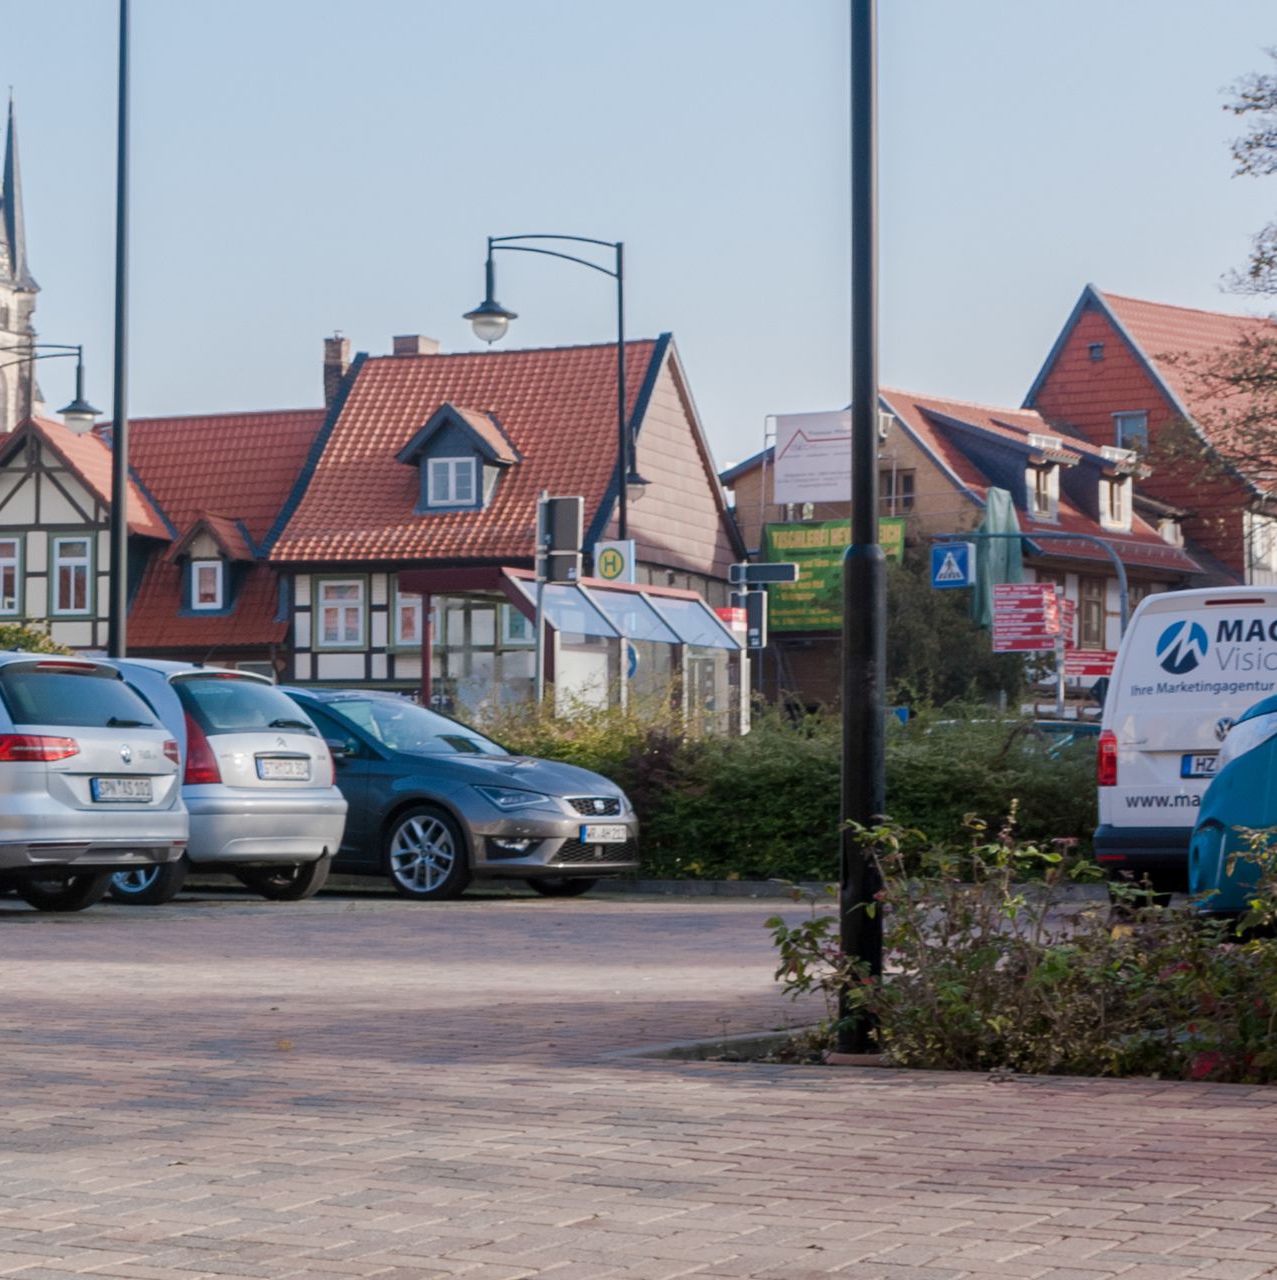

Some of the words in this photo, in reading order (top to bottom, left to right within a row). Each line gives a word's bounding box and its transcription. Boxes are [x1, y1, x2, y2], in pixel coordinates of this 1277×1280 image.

[604, 554, 616, 572] H
[1131, 685, 1154, 696] Ihre
[1157, 681, 1275, 695] Marketingagentur
[1196, 757, 1216, 772] HZ
[1125, 794, 1201, 808] www.ma
